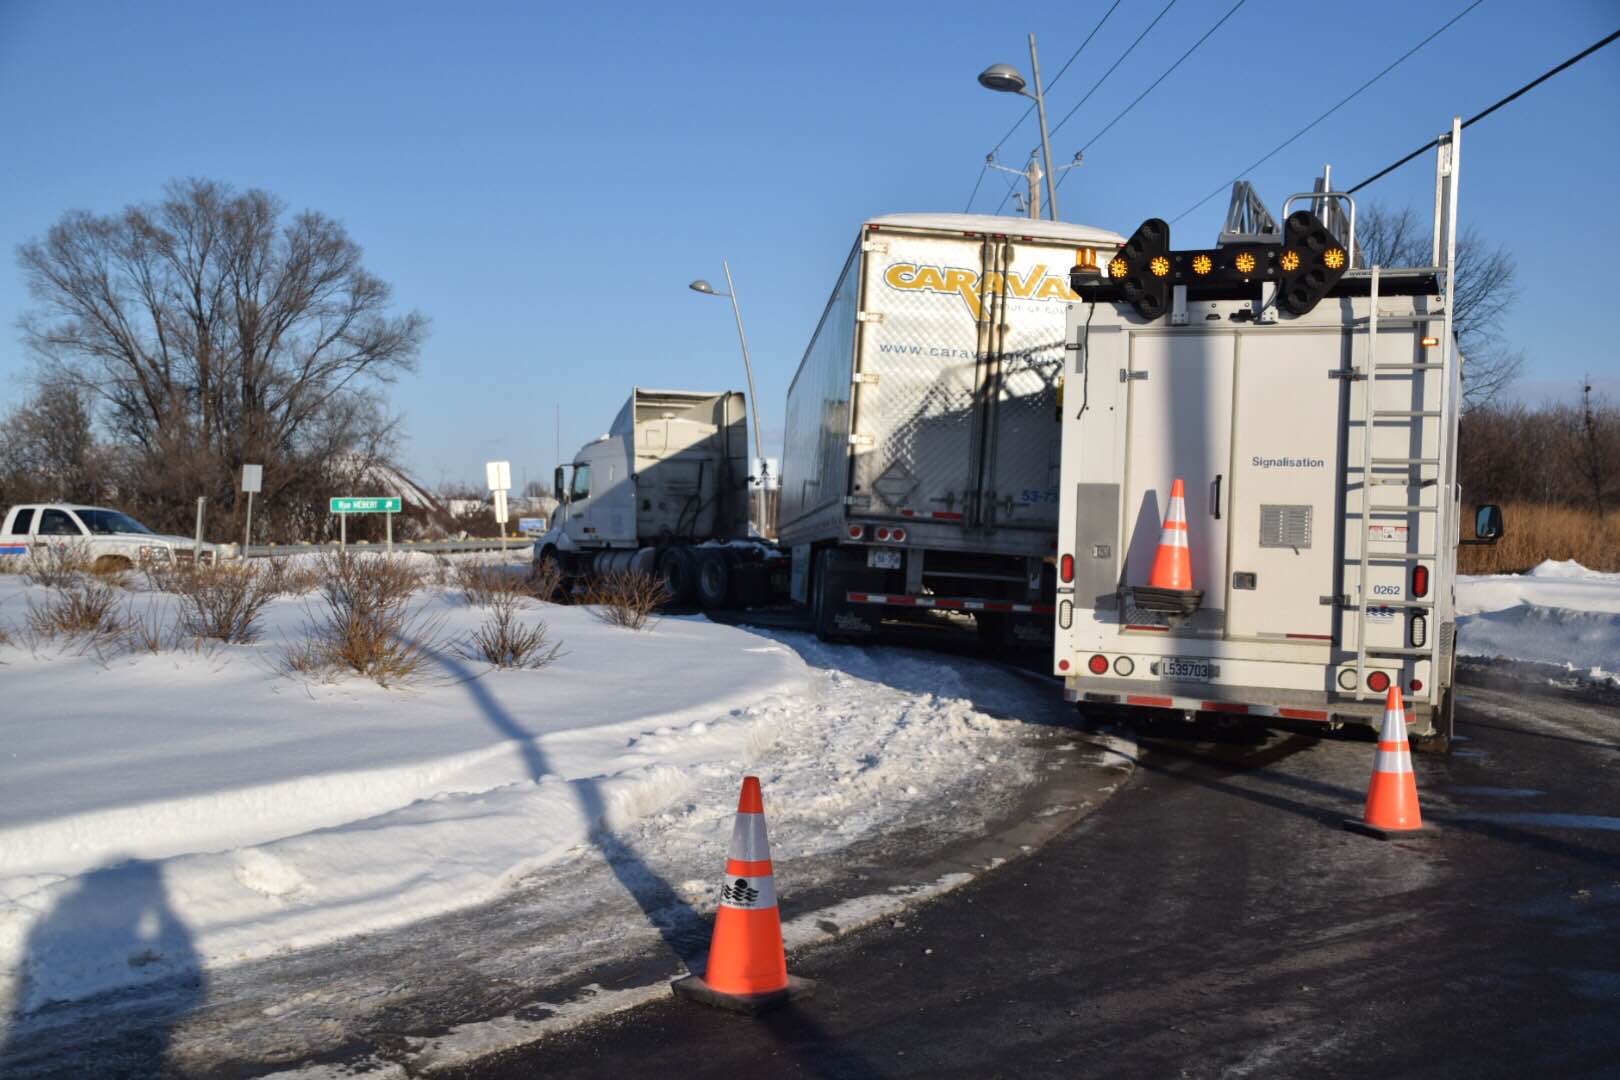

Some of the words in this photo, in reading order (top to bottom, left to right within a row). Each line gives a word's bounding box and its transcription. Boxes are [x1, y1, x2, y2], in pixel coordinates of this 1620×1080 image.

[1252, 456, 1325, 469] Signalisation
[1373, 585, 1401, 595] 0262
[1163, 662, 1208, 678] L539703
